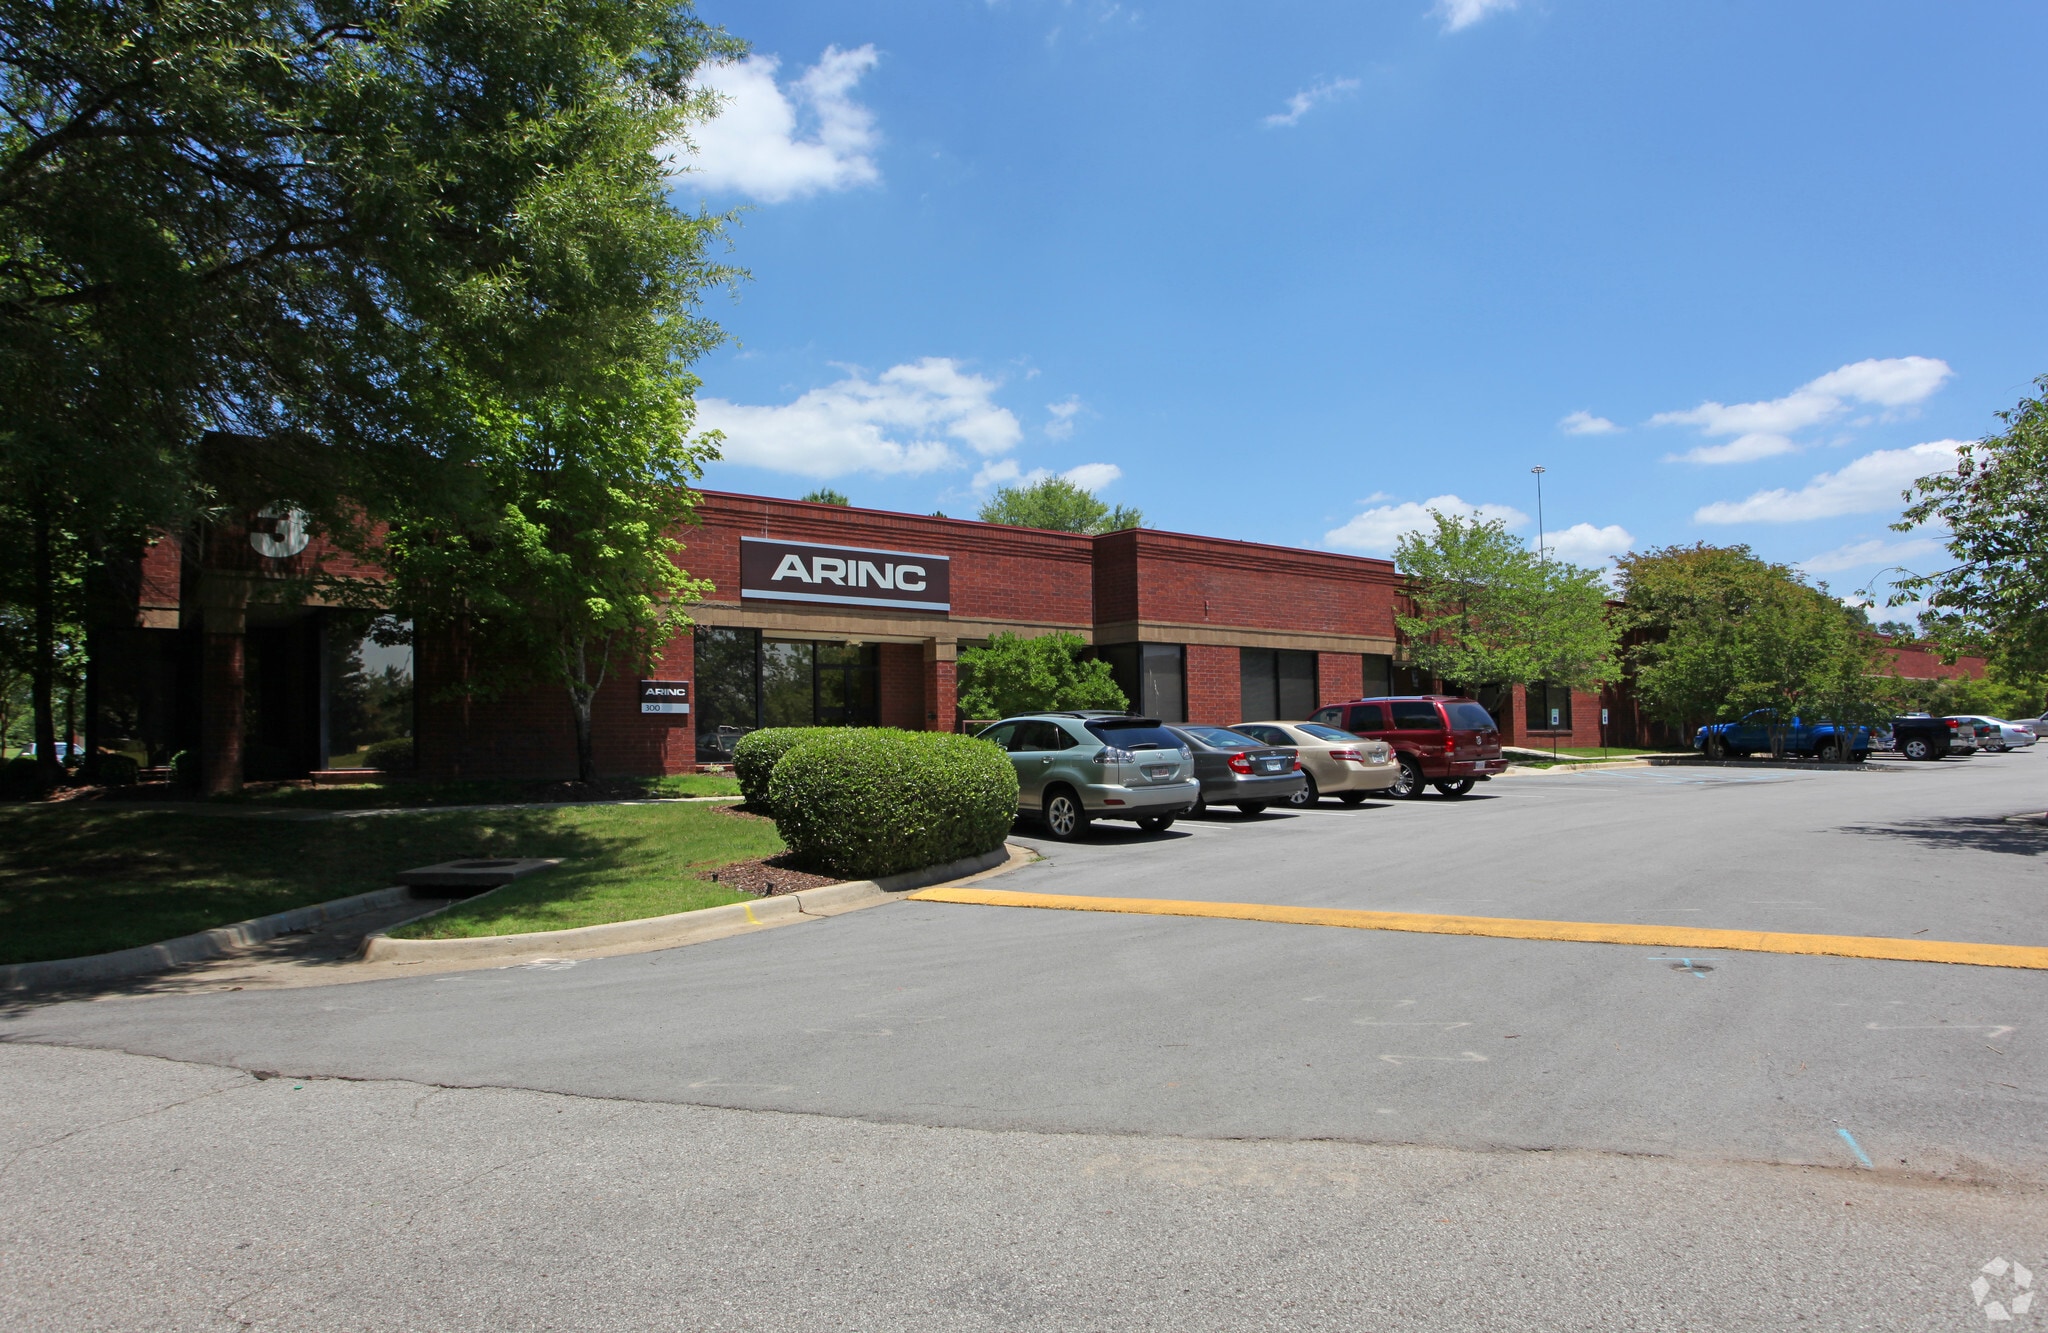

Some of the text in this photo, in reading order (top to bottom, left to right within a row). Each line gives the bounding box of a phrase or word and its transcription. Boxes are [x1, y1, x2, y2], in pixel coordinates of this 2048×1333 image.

[250, 499, 310, 558] 3
[771, 554, 927, 591] ARINC
[645, 688, 686, 696] ARINC
[645, 704, 661, 712] 300
